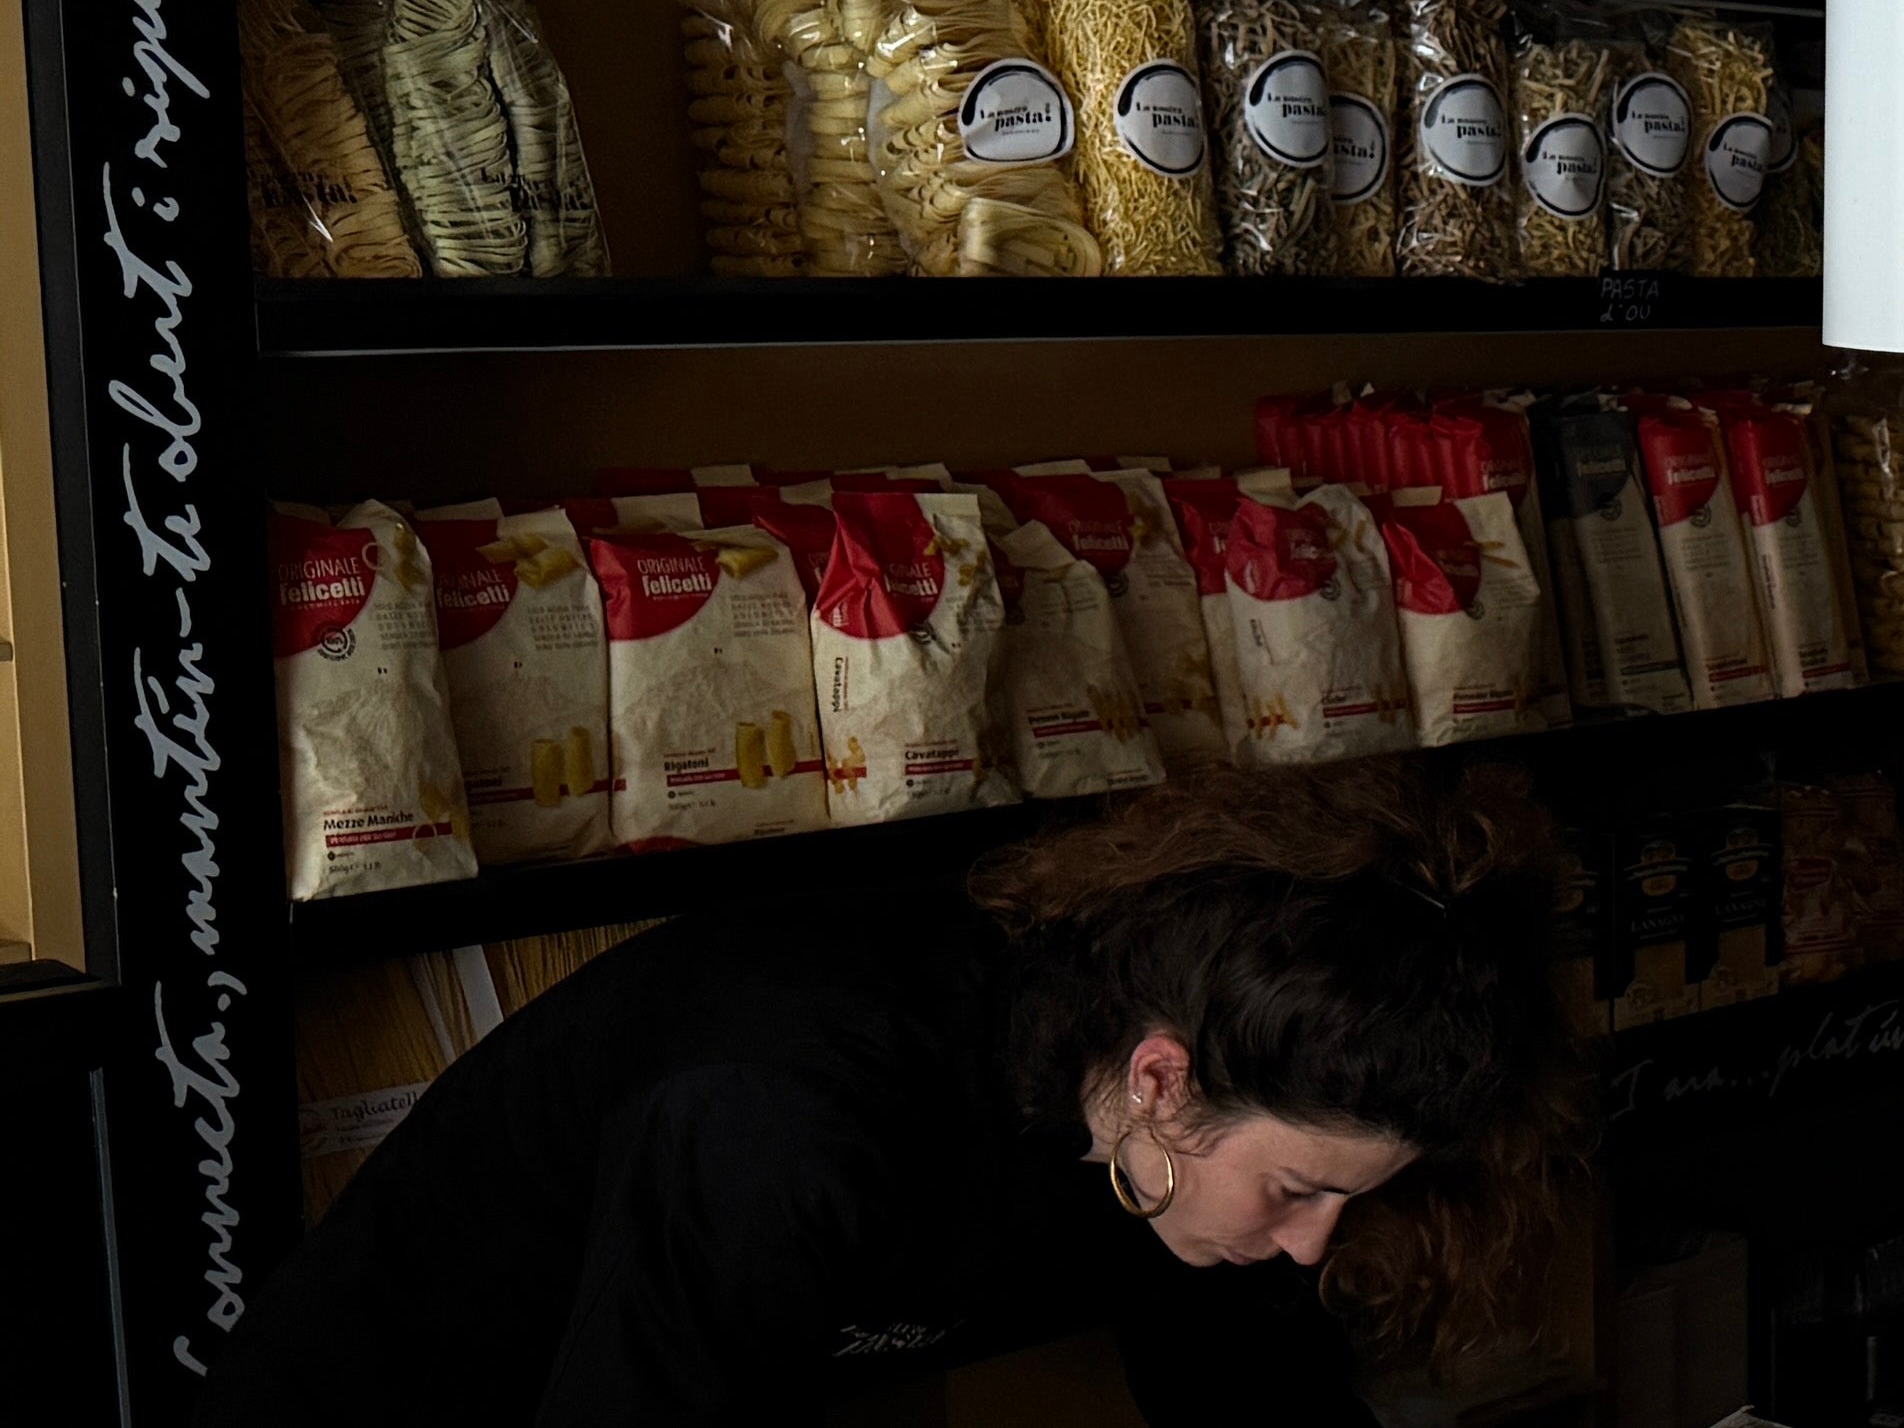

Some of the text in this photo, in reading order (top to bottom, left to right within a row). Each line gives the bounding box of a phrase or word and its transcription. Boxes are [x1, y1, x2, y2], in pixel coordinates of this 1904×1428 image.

[994, 103, 1053, 133] pasta!
[1600, 276, 1660, 301] PASTA
[278, 573, 366, 606] felicetti
[436, 583, 511, 609] felicetti
[642, 572, 713, 598] felicetti
